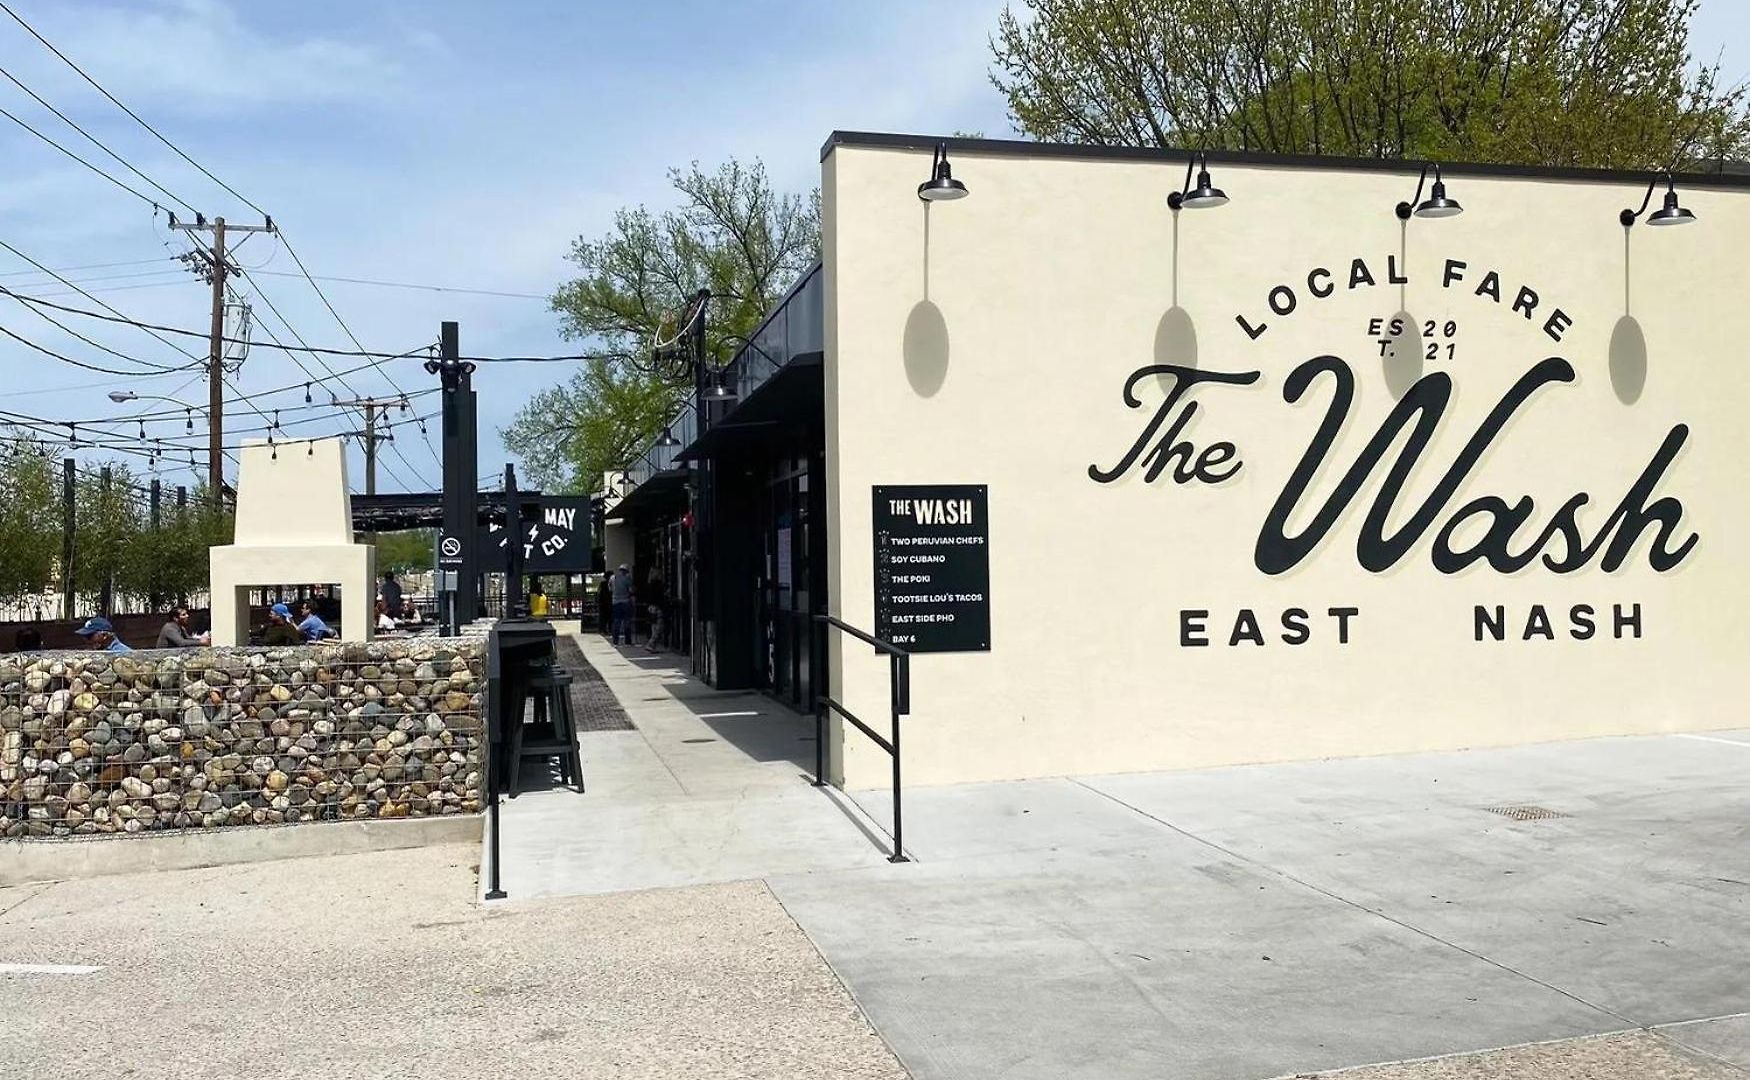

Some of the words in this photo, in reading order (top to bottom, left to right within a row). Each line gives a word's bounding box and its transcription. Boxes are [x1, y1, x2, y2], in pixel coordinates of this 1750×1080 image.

[1235, 255, 1408, 340] LOCAL
[1443, 259, 1573, 343] FARE
[1422, 320, 1457, 338] 20
[1425, 342, 1457, 360] 21
[1088, 364, 1261, 485] The
[1254, 355, 1700, 576] Wash
[544, 508, 577, 531] MAY
[888, 499, 912, 516] THE
[913, 499, 973, 525] WASH
[541, 534, 569, 556] CO.
[890, 537, 911, 546] TWO
[911, 537, 955, 546] PERUVIAN
[955, 536, 984, 545] CHEFS
[890, 555, 909, 564] SOY
[909, 555, 946, 564] CUBANO
[891, 575, 909, 584] THE
[910, 575, 931, 584] POKI
[891, 595, 929, 604] TOOTSIE
[929, 592, 954, 603] LOU'S
[954, 593, 983, 602] TACOS
[891, 614, 915, 624] EAST
[915, 614, 935, 623] SIDE
[936, 614, 955, 623] PHO
[1181, 606, 1359, 647] EAST
[1475, 603, 1642, 641] NASH
[892, 635, 909, 644] BAY
[909, 634, 916, 643] 6
